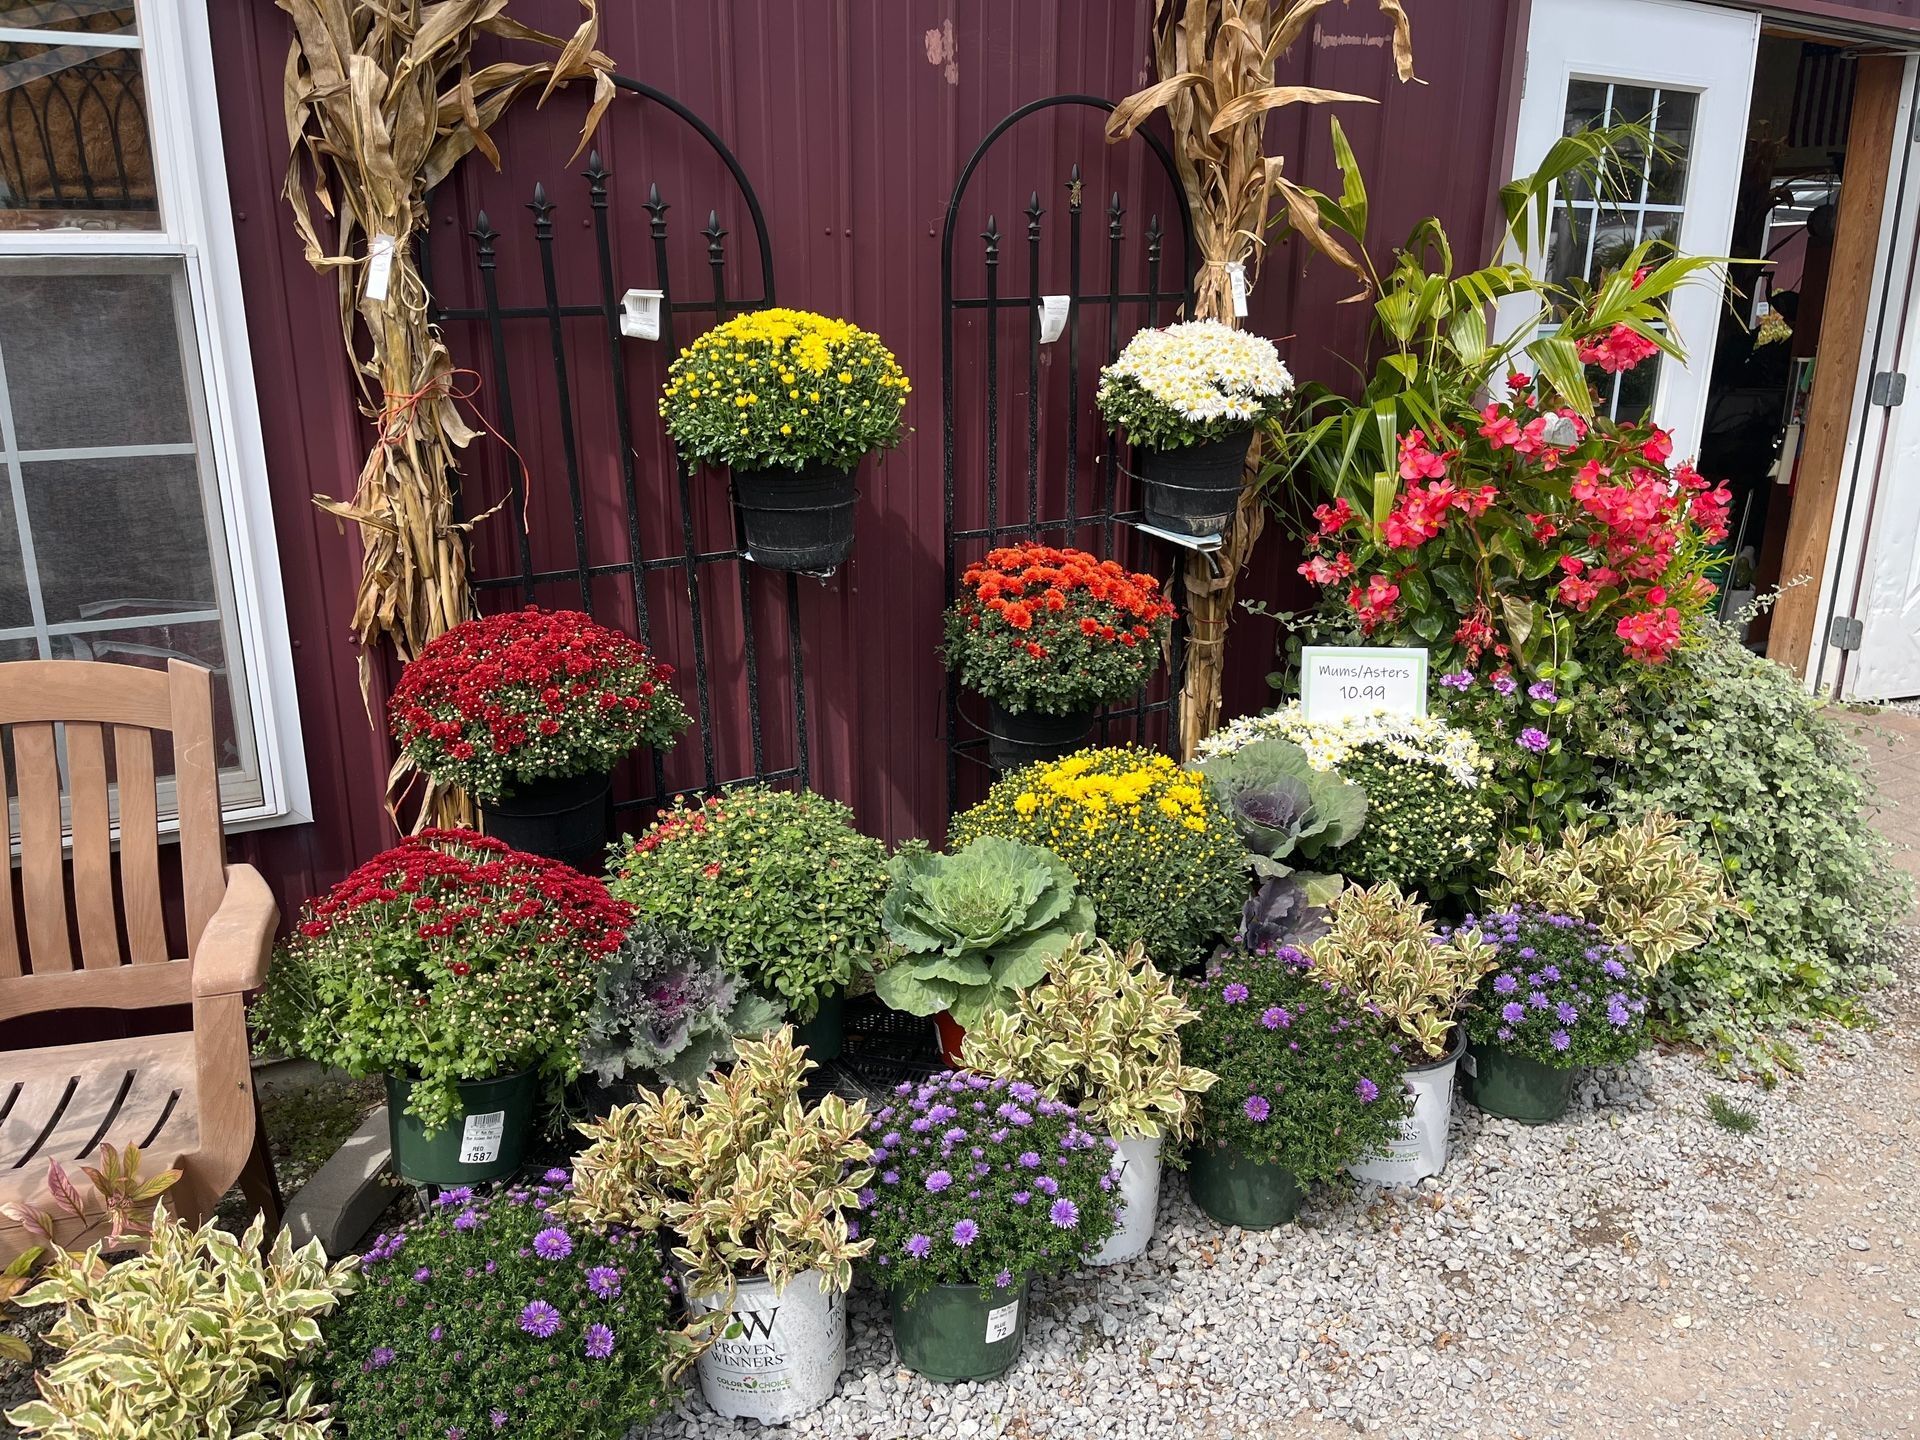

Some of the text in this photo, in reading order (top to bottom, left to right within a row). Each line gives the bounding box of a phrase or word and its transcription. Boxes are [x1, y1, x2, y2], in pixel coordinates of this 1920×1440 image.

[1318, 665, 1410, 679] Mums/Asters
[1339, 685, 1386, 700] 10.99
[467, 1152, 492, 1161] 1587
[996, 1327, 1006, 1338] 72
[714, 1341, 776, 1356] PROVEN
[711, 1351, 785, 1368] WINNERS
[716, 1376, 792, 1389] COLOR CHOICE
